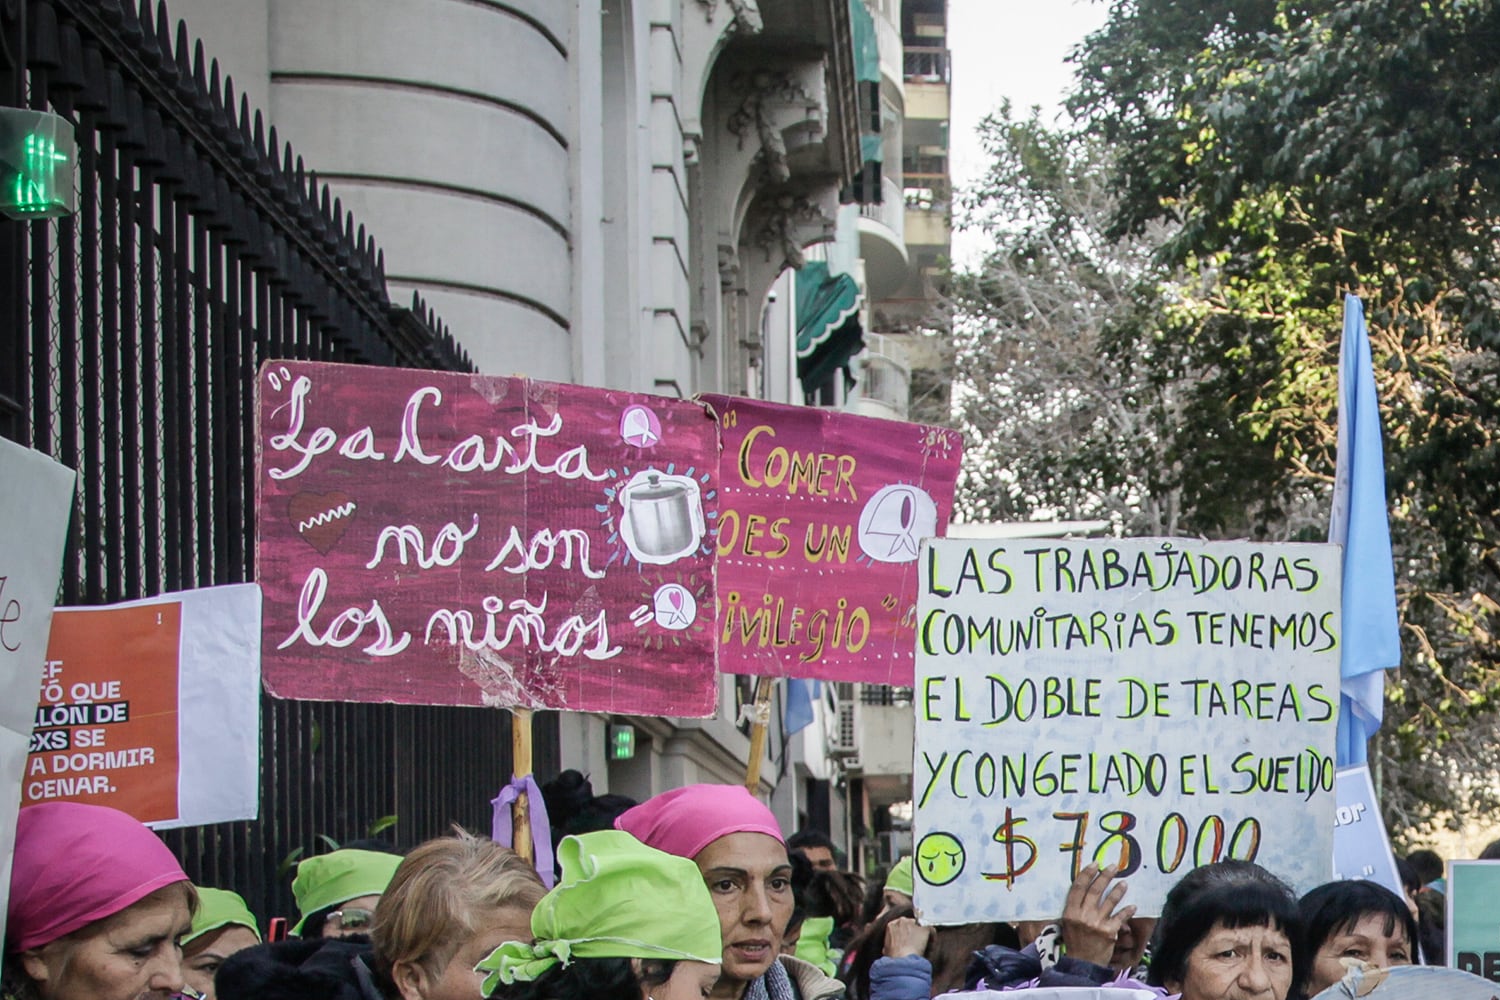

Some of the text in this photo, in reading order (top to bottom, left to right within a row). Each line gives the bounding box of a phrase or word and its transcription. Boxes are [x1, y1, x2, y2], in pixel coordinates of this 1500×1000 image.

[393, 386, 610, 482] Casta
[366, 513, 606, 579] no son
[742, 514, 791, 559] ES
[804, 521, 852, 564] UN
[927, 544, 1015, 598] LAS
[278, 567, 412, 657] los
[1187, 609, 1339, 653] TENEMOS
[33, 698, 128, 728] LLÓN DE
[71, 679, 121, 705] QUE
[923, 673, 1334, 728] EL DOBLE DE TAREAS
[28, 729, 106, 753] CXS SE
[31, 747, 155, 777] A DORMIR
[28, 776, 117, 800] CENAR.
[918, 746, 1335, 810] Y CONGELADO EL SUELDO
[1335, 802, 1366, 828] or
[981, 806, 1038, 891] $
